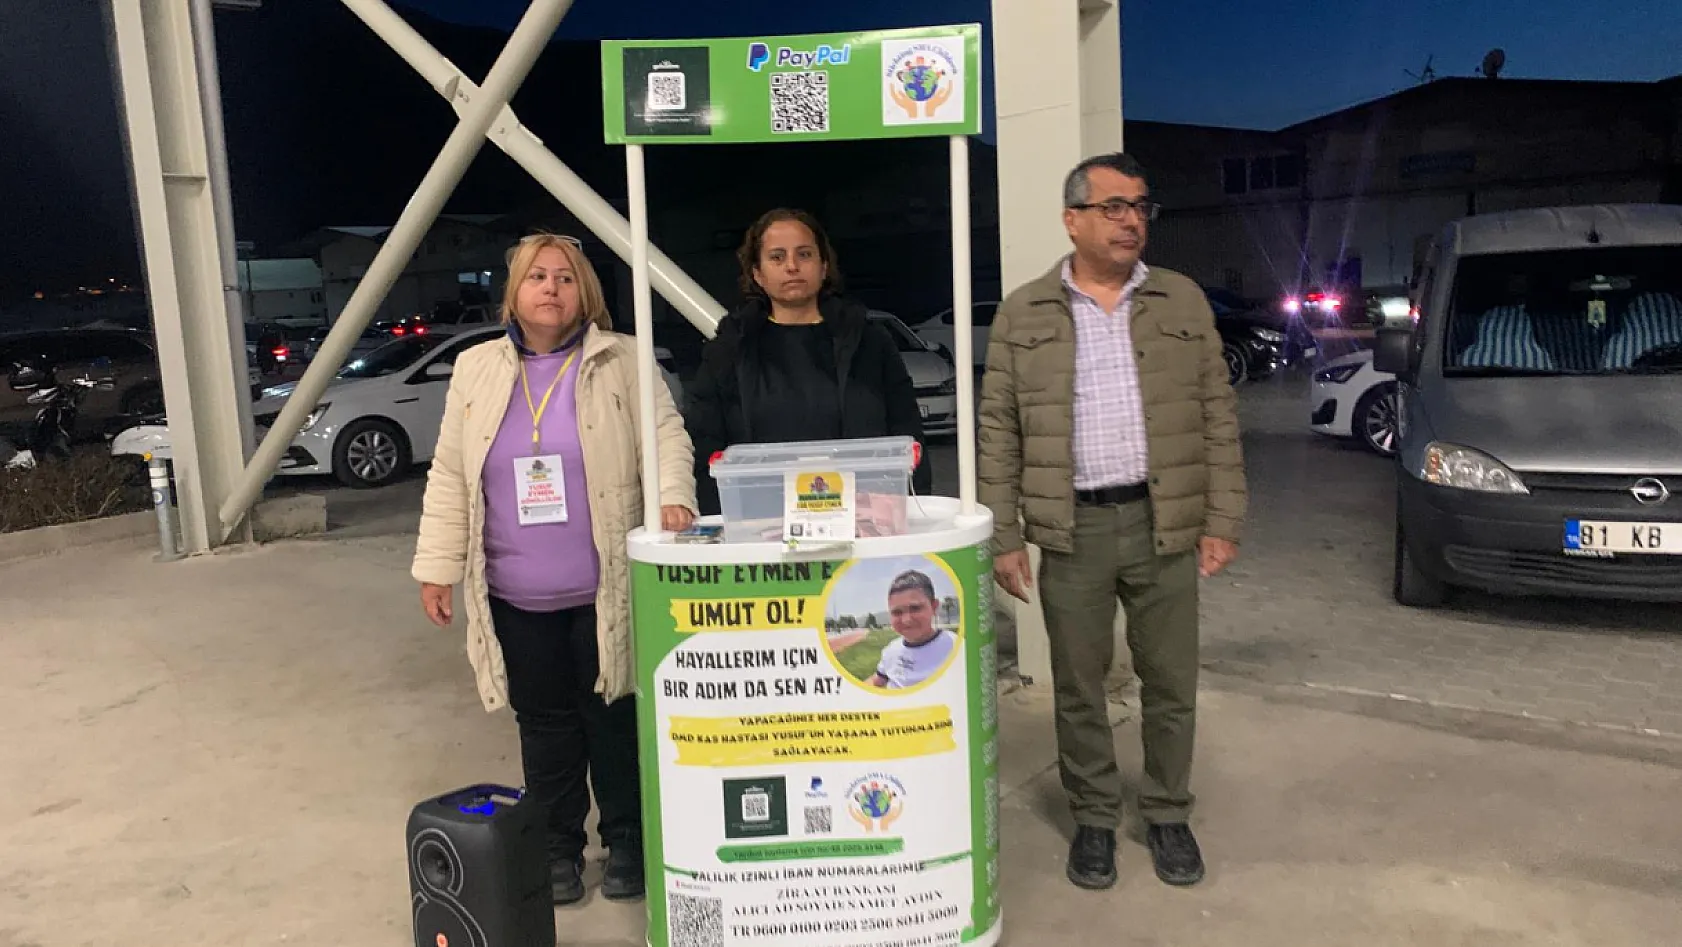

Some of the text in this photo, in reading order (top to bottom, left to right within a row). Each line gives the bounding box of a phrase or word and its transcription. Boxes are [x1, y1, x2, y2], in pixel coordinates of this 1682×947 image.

[776, 45, 850, 68] PayPal
[1581, 525, 1607, 546] 81
[1632, 525, 1661, 548] KB
[656, 564, 723, 584] YUSUF
[689, 598, 805, 626] UMUT OL!
[695, 681, 737, 700] ADIM
[745, 679, 768, 697] DA
[774, 678, 807, 696] SEN
[813, 676, 842, 695] AT!
